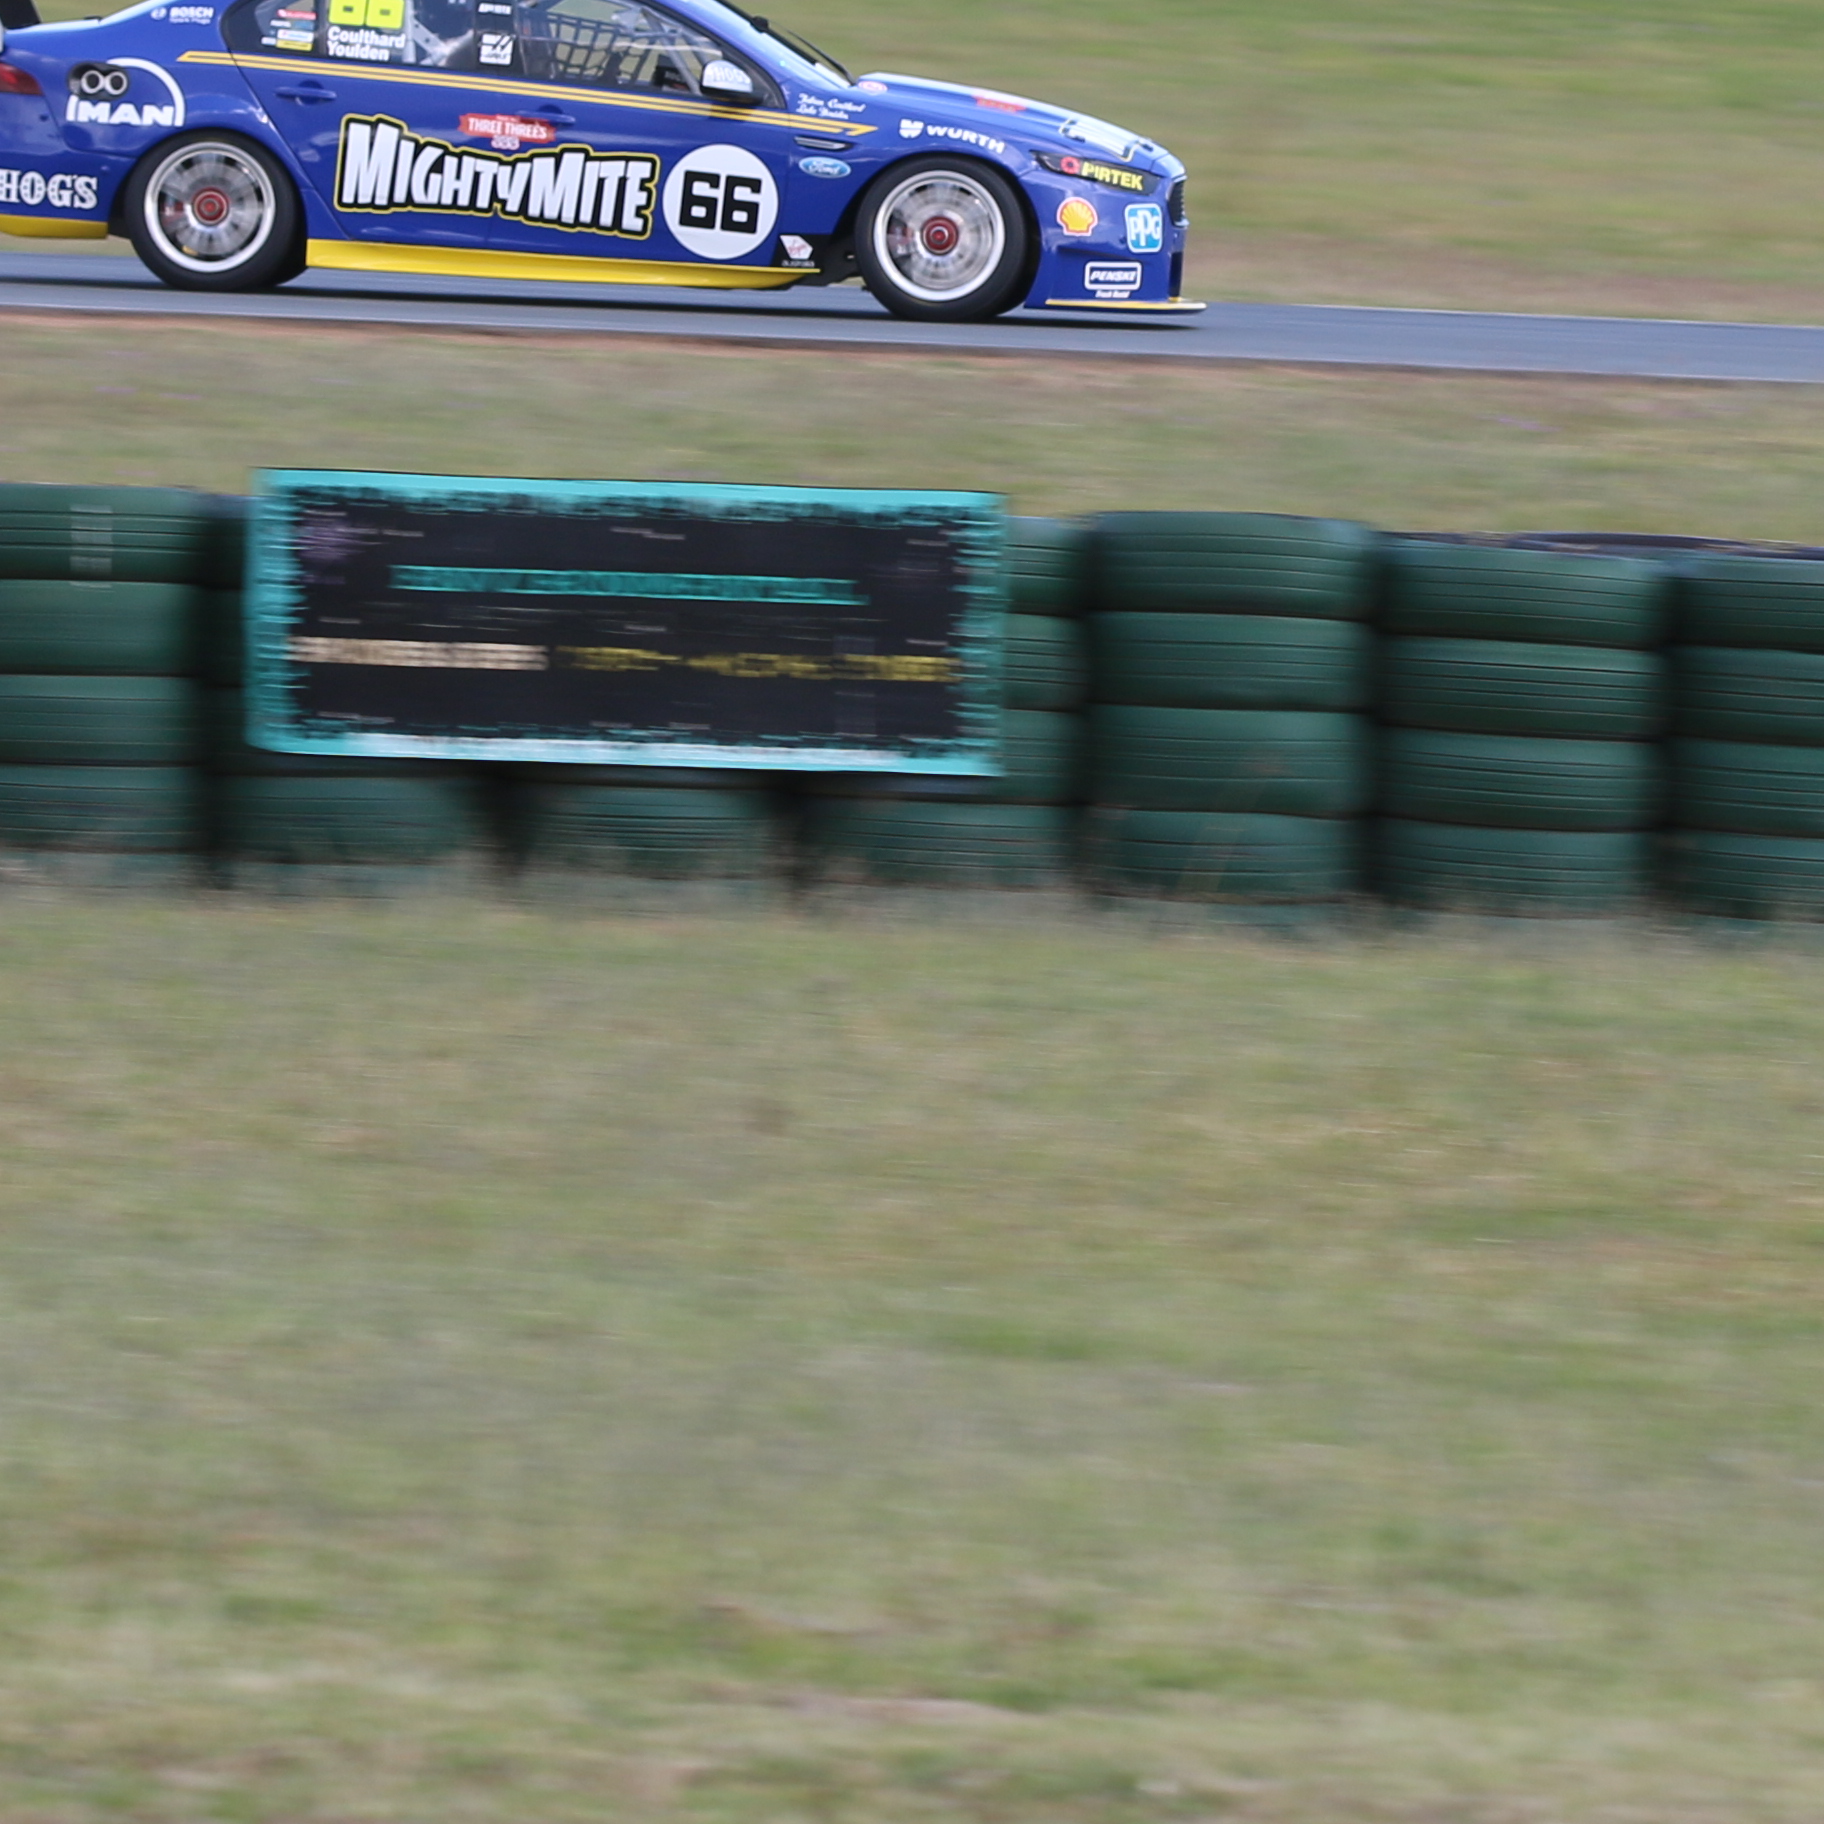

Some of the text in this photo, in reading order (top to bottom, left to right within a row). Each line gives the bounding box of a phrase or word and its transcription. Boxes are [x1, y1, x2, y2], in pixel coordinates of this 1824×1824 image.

[327, 26, 406, 49] Coulthard
[327, 41, 389, 62] Youlden
[76, 100, 174, 126] MAN
[1081, 161, 1143, 191] PIRTEK
[679, 170, 762, 235] 66
[1129, 209, 1160, 247] PPG
